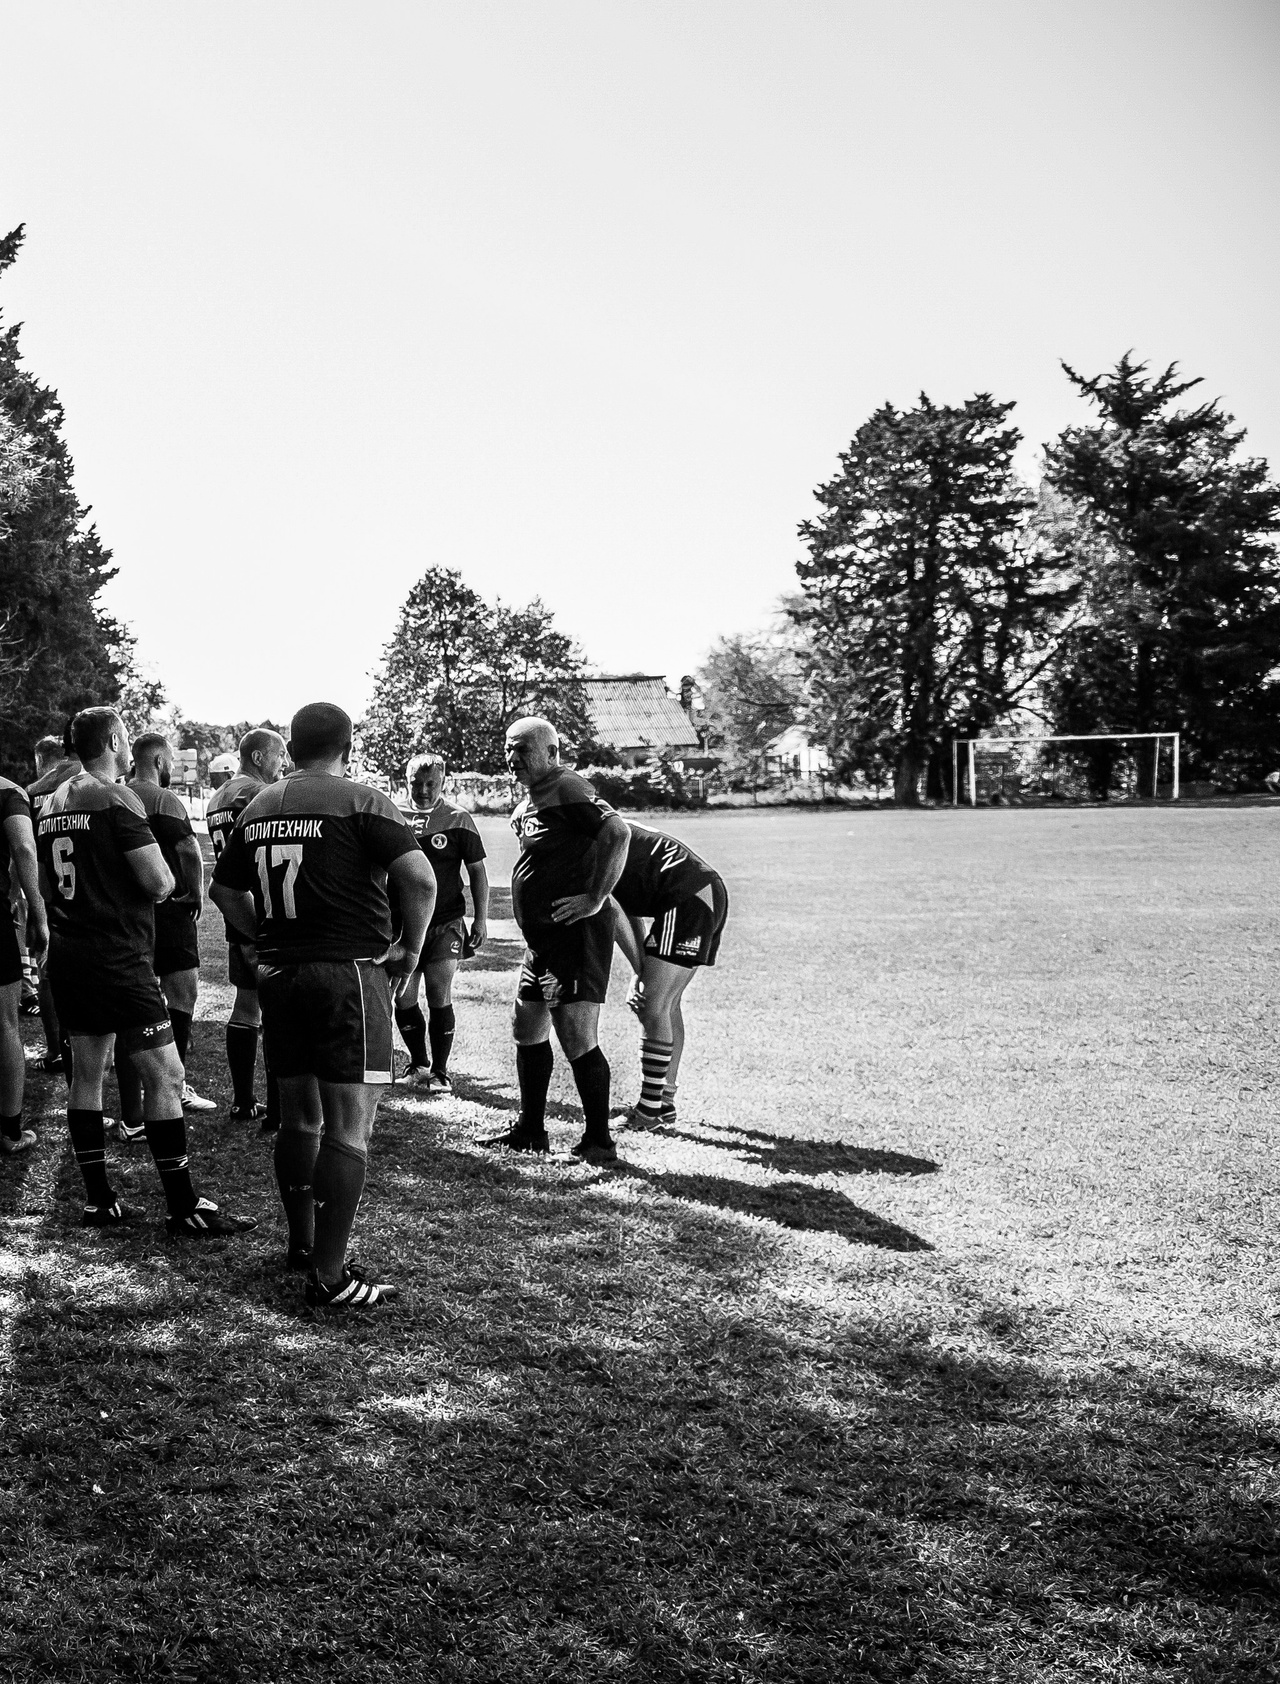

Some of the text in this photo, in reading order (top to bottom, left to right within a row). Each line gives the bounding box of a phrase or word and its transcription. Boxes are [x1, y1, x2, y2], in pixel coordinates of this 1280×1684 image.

[244, 820, 323, 844] ПОЛИТЕХНИК
[51, 836, 76, 900] 6
[254, 844, 303, 919] 17
